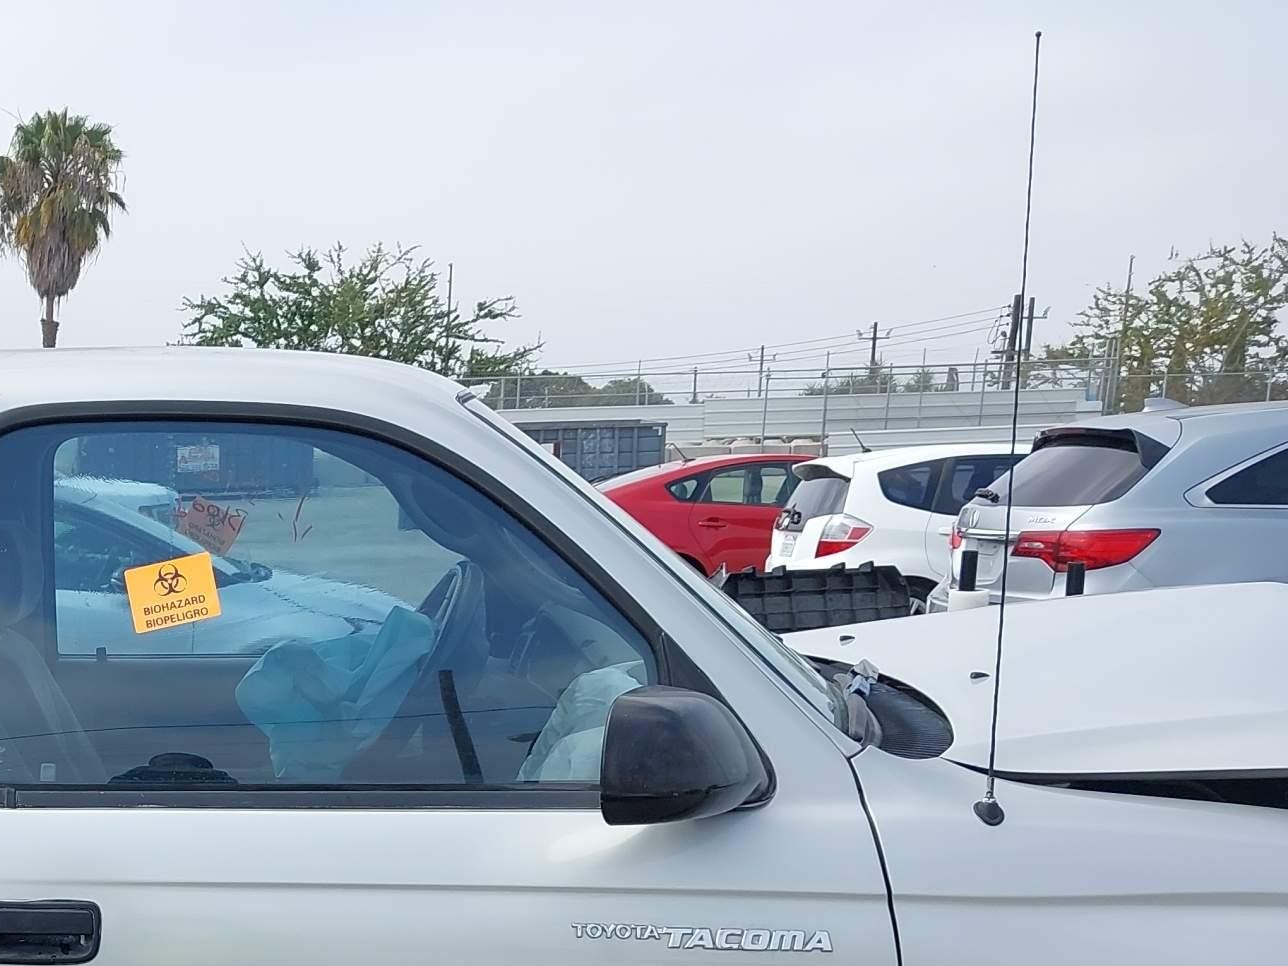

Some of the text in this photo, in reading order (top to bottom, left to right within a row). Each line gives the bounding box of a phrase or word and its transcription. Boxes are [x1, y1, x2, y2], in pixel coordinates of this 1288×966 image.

[143, 594, 206, 616] BIOHAZARD
[145, 607, 209, 629] BIOPELIGRO
[571, 922, 834, 952] TOYOTA TACOMA
